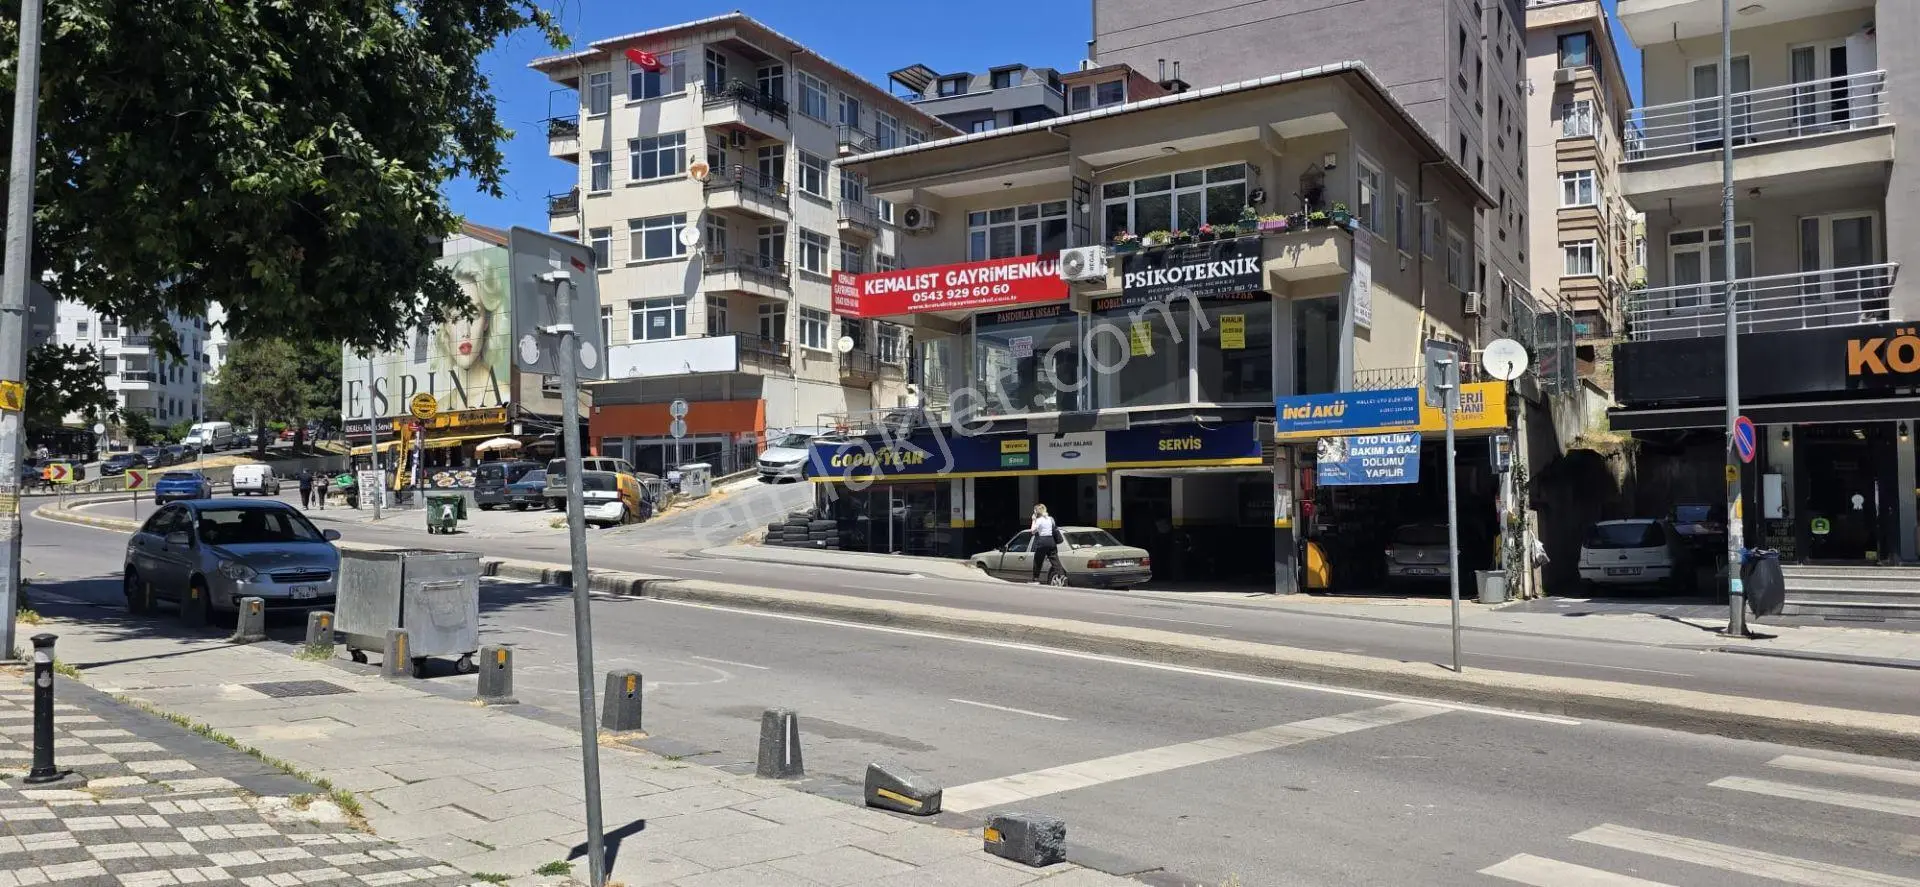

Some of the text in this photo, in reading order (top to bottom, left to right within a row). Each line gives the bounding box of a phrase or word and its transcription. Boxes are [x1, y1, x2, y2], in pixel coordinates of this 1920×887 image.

[1124, 252, 1260, 289] PSİKOTEKNİK
[912, 283, 1010, 303] 0543 929 60 60
[346, 364, 505, 419] ESPINA
[1158, 435, 1202, 451] SERVİS
[1357, 435, 1378, 445] OTO
[1386, 447, 1394, 455] &
[1395, 444, 1417, 454] GAZ
[1362, 457, 1405, 467] DOLUMU
